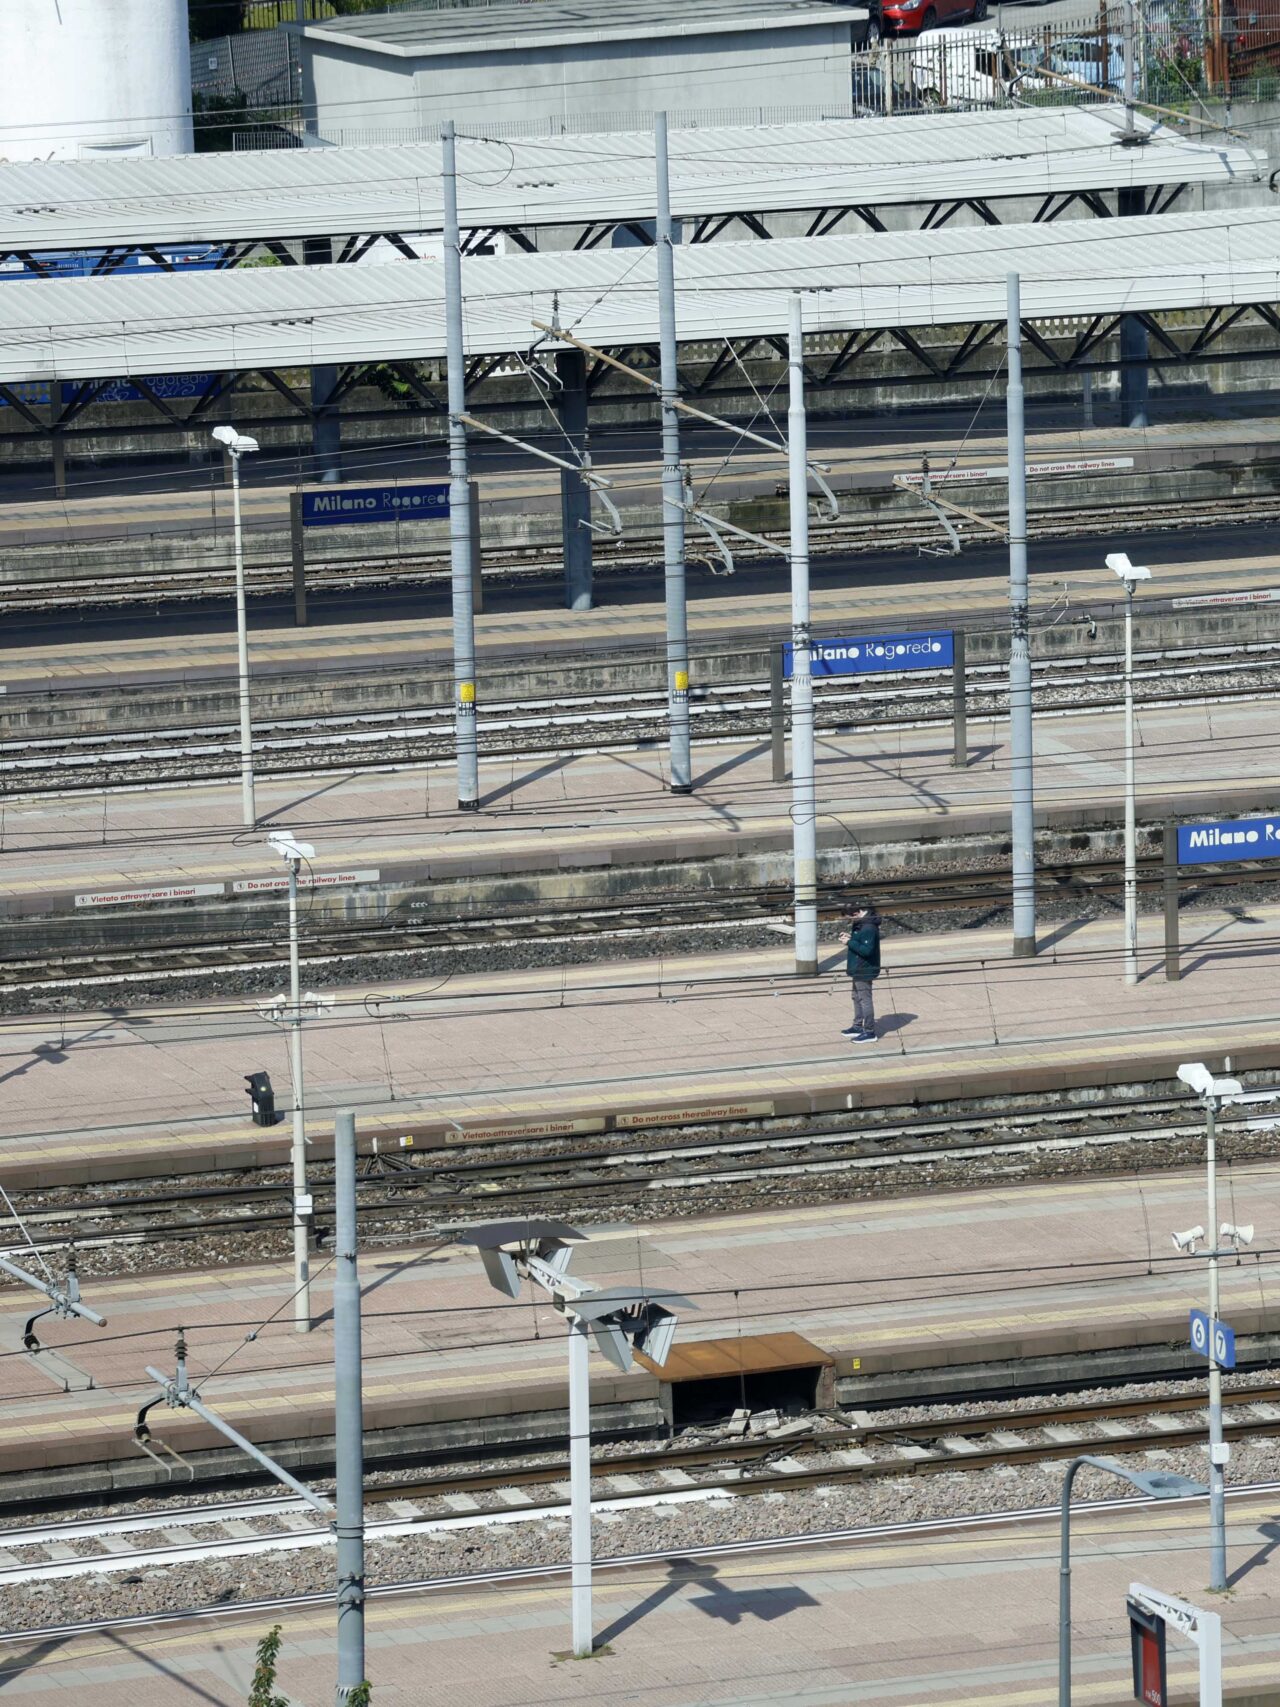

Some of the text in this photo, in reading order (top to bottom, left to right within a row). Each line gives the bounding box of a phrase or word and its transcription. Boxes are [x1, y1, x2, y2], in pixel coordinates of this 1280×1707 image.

[313, 495, 377, 512] Milano
[809, 637, 942, 661] ilano Rogoredo
[1189, 828, 1259, 848] Milano
[259, 881, 272, 889] not
[308, 876, 337, 885] railway
[338, 874, 356, 882] lines
[90, 895, 119, 903] Vietato
[120, 892, 168, 901] attraversare
[173, 887, 196, 896] binari
[632, 1116, 644, 1124] Do
[660, 1113, 681, 1121] cross
[682, 1111, 696, 1119] the
[696, 1109, 728, 1118] railway
[728, 1106, 748, 1114] lines
[462, 1131, 492, 1140] Vietato
[493, 1127, 544, 1137] attraversare
[1195, 1323, 1203, 1343] 6
[1217, 1334, 1224, 1355] 7
